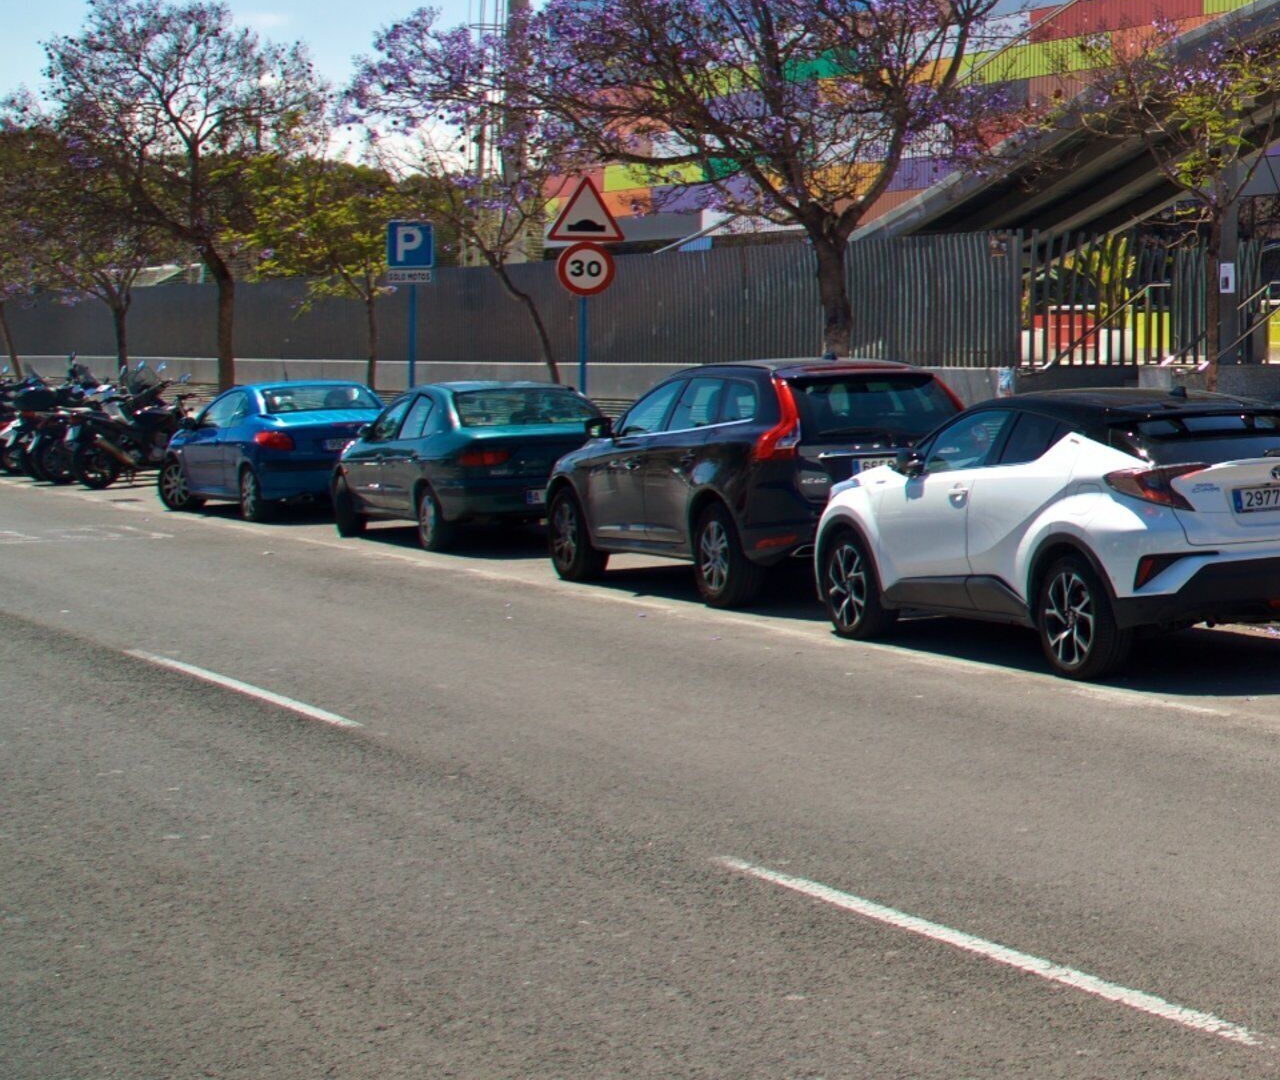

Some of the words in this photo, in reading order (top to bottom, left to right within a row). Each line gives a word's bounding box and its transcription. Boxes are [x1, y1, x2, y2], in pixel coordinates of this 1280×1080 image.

[396, 226, 423, 262] P
[387, 271, 406, 282] SOLO
[407, 271, 432, 282] MOTOS
[570, 259, 603, 278] 30
[1245, 488, 1280, 508] 2977
